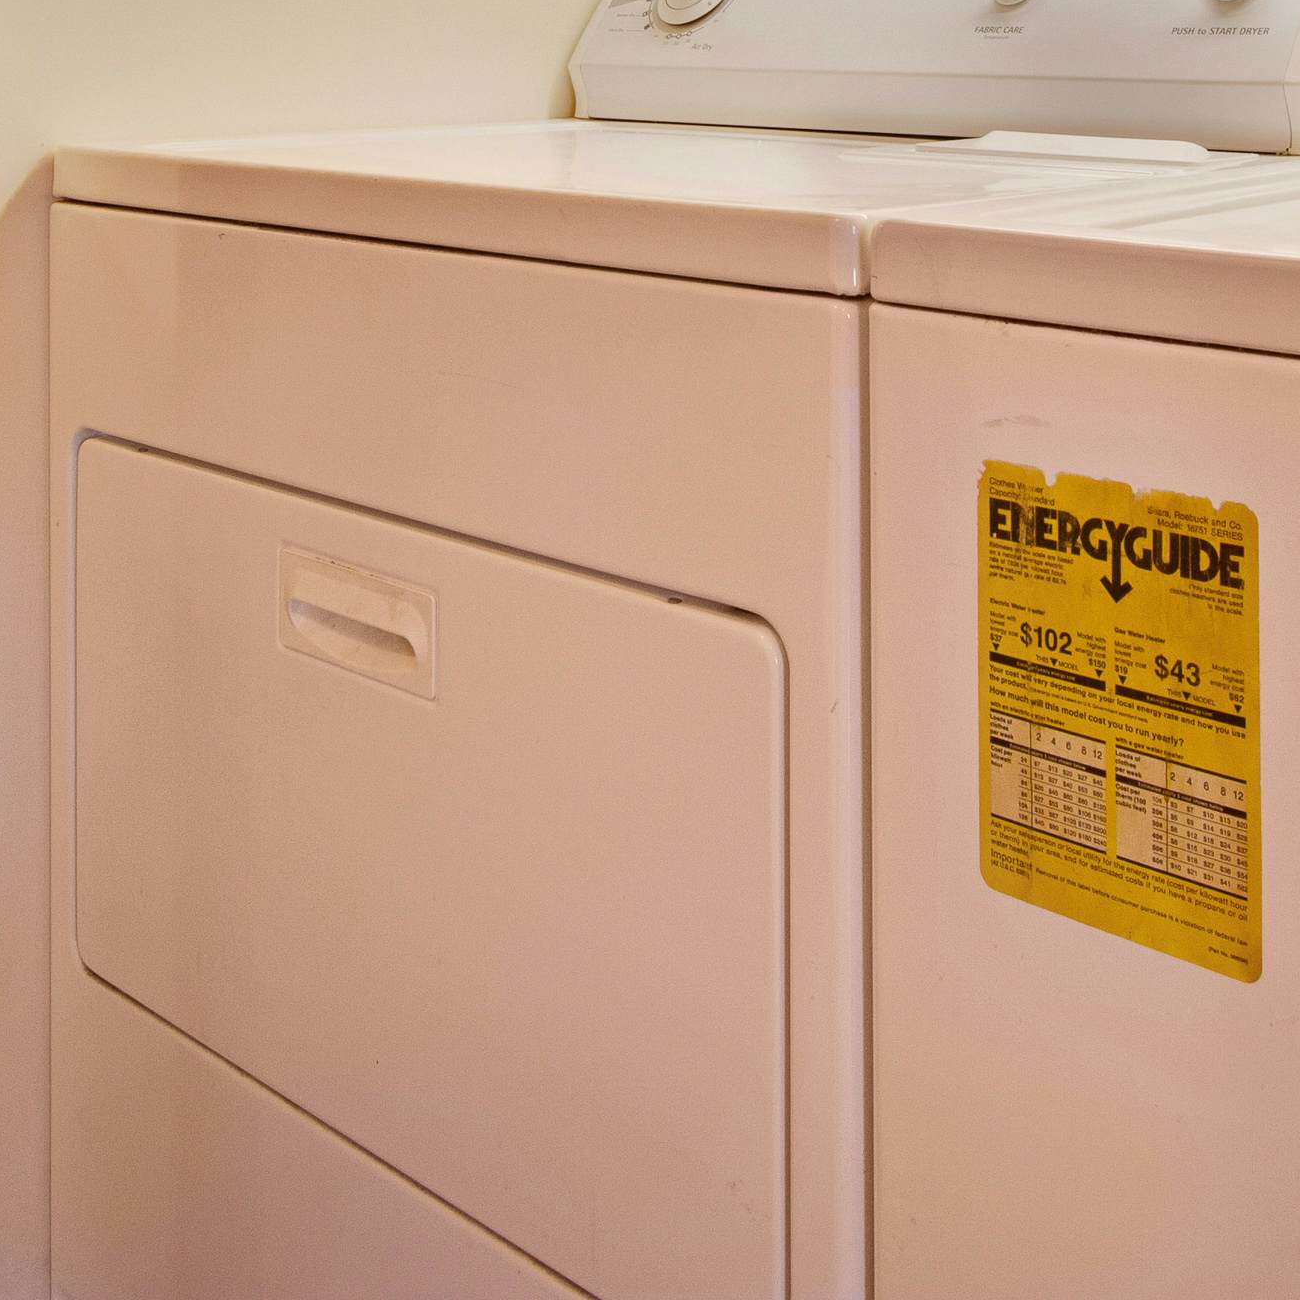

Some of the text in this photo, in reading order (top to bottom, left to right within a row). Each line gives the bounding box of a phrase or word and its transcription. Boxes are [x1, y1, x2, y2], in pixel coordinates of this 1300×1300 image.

[973, 25, 1025, 35] FABRIC CARE
[1171, 27, 1271, 36] PUSH to START DRYER
[1174, 510, 1208, 525] Roebuck
[1211, 517, 1226, 528] and
[1228, 520, 1243, 531] Co.
[989, 500, 1245, 590] ENERGYGUIDE
[1210, 527, 1243, 542] SERIES
[989, 632, 1002, 643] $37
[1019, 620, 1073, 656] $102
[1088, 657, 1106, 670] $150
[1114, 663, 1128, 676] $19
[1153, 652, 1201, 689] $43
[988, 672, 1027, 691] the product.
[988, 663, 1004, 675] Your
[1004, 668, 1019, 679] cost
[1020, 672, 1032, 682] will
[1032, 676, 1048, 688] vary
[1049, 679, 1086, 698] depending
[1087, 690, 1097, 699] on
[1098, 693, 1115, 706] your
[1116, 697, 1134, 709] local
[1135, 703, 1162, 719] energy
[1163, 710, 1178, 721] rate
[1180, 714, 1195, 726] and
[1196, 719, 1214, 731] how
[1214, 724, 1230, 737] you
[1231, 729, 1246, 739] use
[988, 684, 1184, 750] How much will this model cost you to run yearly?
[1035, 731, 1042, 742] 2
[1050, 736, 1056, 746] 4
[1092, 749, 1103, 761] 12
[1125, 768, 1142, 778] week
[1169, 771, 1176, 782] 2
[1185, 775, 1192, 786] 4
[1219, 785, 1227, 797] 8
[1232, 789, 1244, 802] 12
[1065, 844, 1081, 857] local
[1082, 850, 1101, 864] utility
[1126, 866, 1149, 881] energy
[1151, 873, 1165, 885] rate
[1185, 886, 1198, 897] per
[1199, 889, 1228, 906] kilowatt
[1229, 899, 1247, 912] hour
